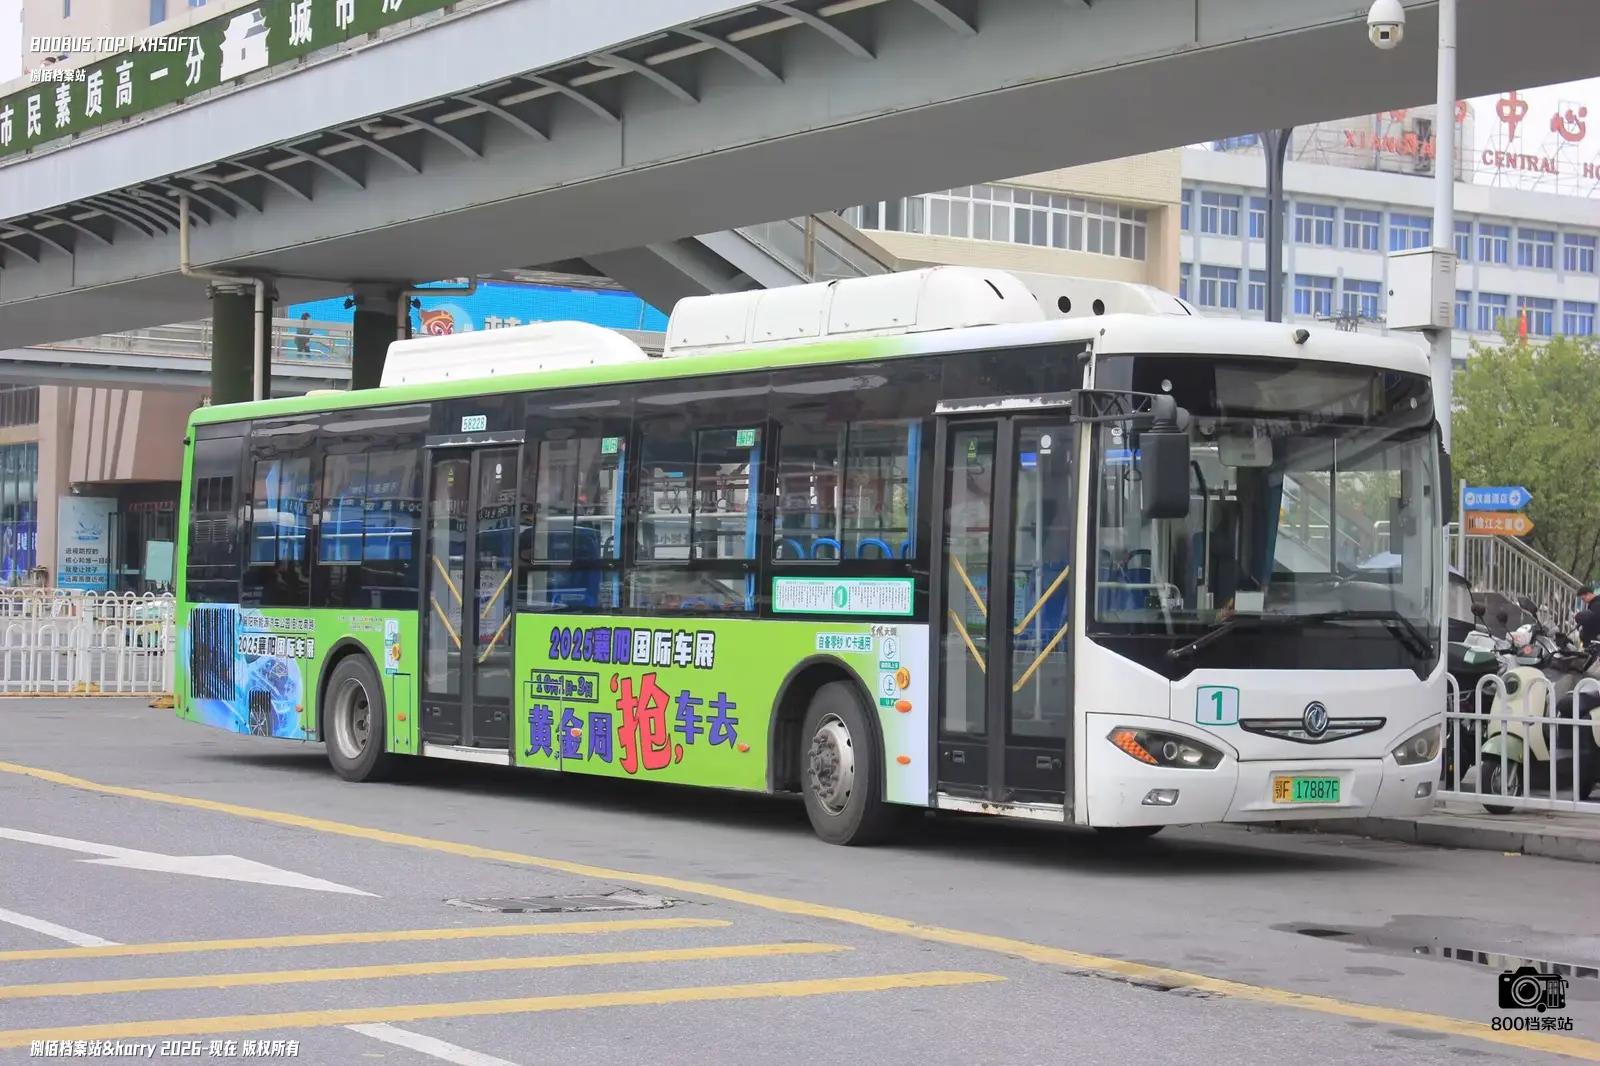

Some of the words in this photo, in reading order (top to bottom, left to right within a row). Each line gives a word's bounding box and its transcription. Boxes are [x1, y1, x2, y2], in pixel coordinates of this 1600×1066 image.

[1482, 149, 1559, 176] CENTRAL
[238, 635, 315, 660] 2025襄阳国际车展
[548, 626, 716, 670] 2025襄阳国际车展
[1210, 691, 1224, 721] 1
[1296, 780, 1339, 799] 17887F
